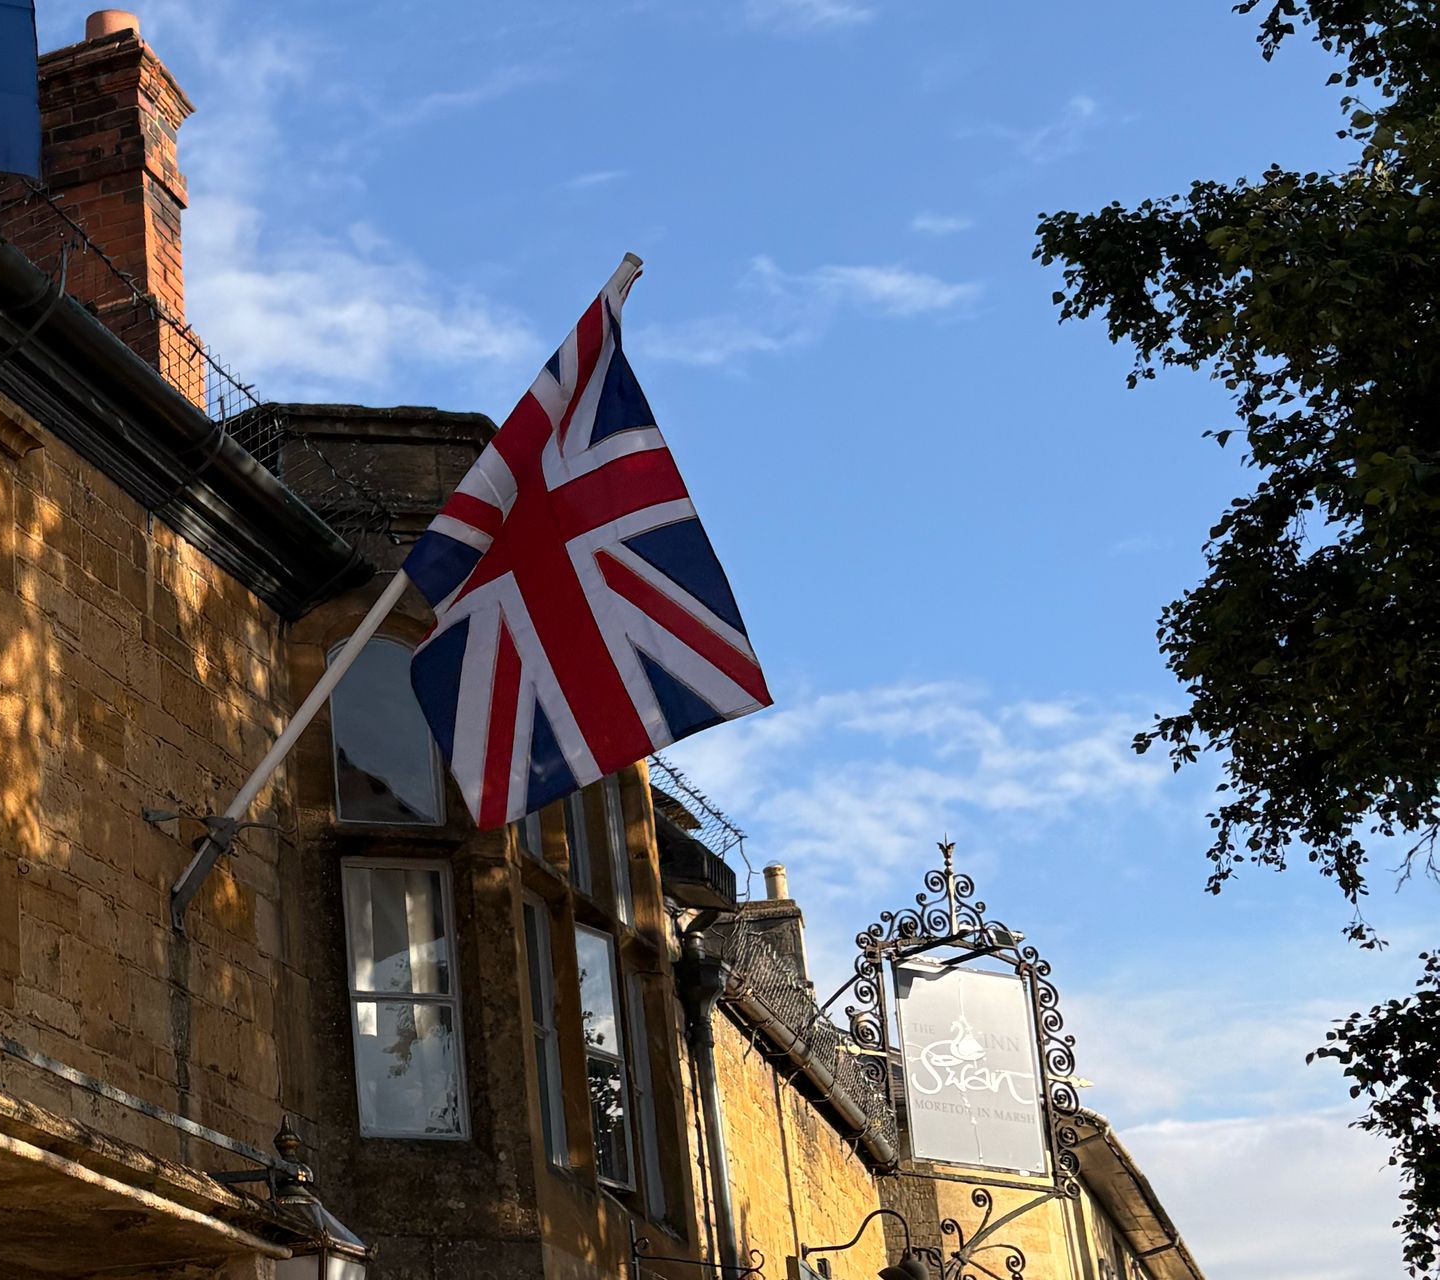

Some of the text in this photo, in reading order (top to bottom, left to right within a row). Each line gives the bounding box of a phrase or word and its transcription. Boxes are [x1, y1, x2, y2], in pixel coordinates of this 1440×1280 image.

[912, 1023, 1021, 1053] THE INN
[911, 1040, 1035, 1105] Swan
[977, 1106, 991, 1119] IN
[994, 1109, 1035, 1124] MARSH
